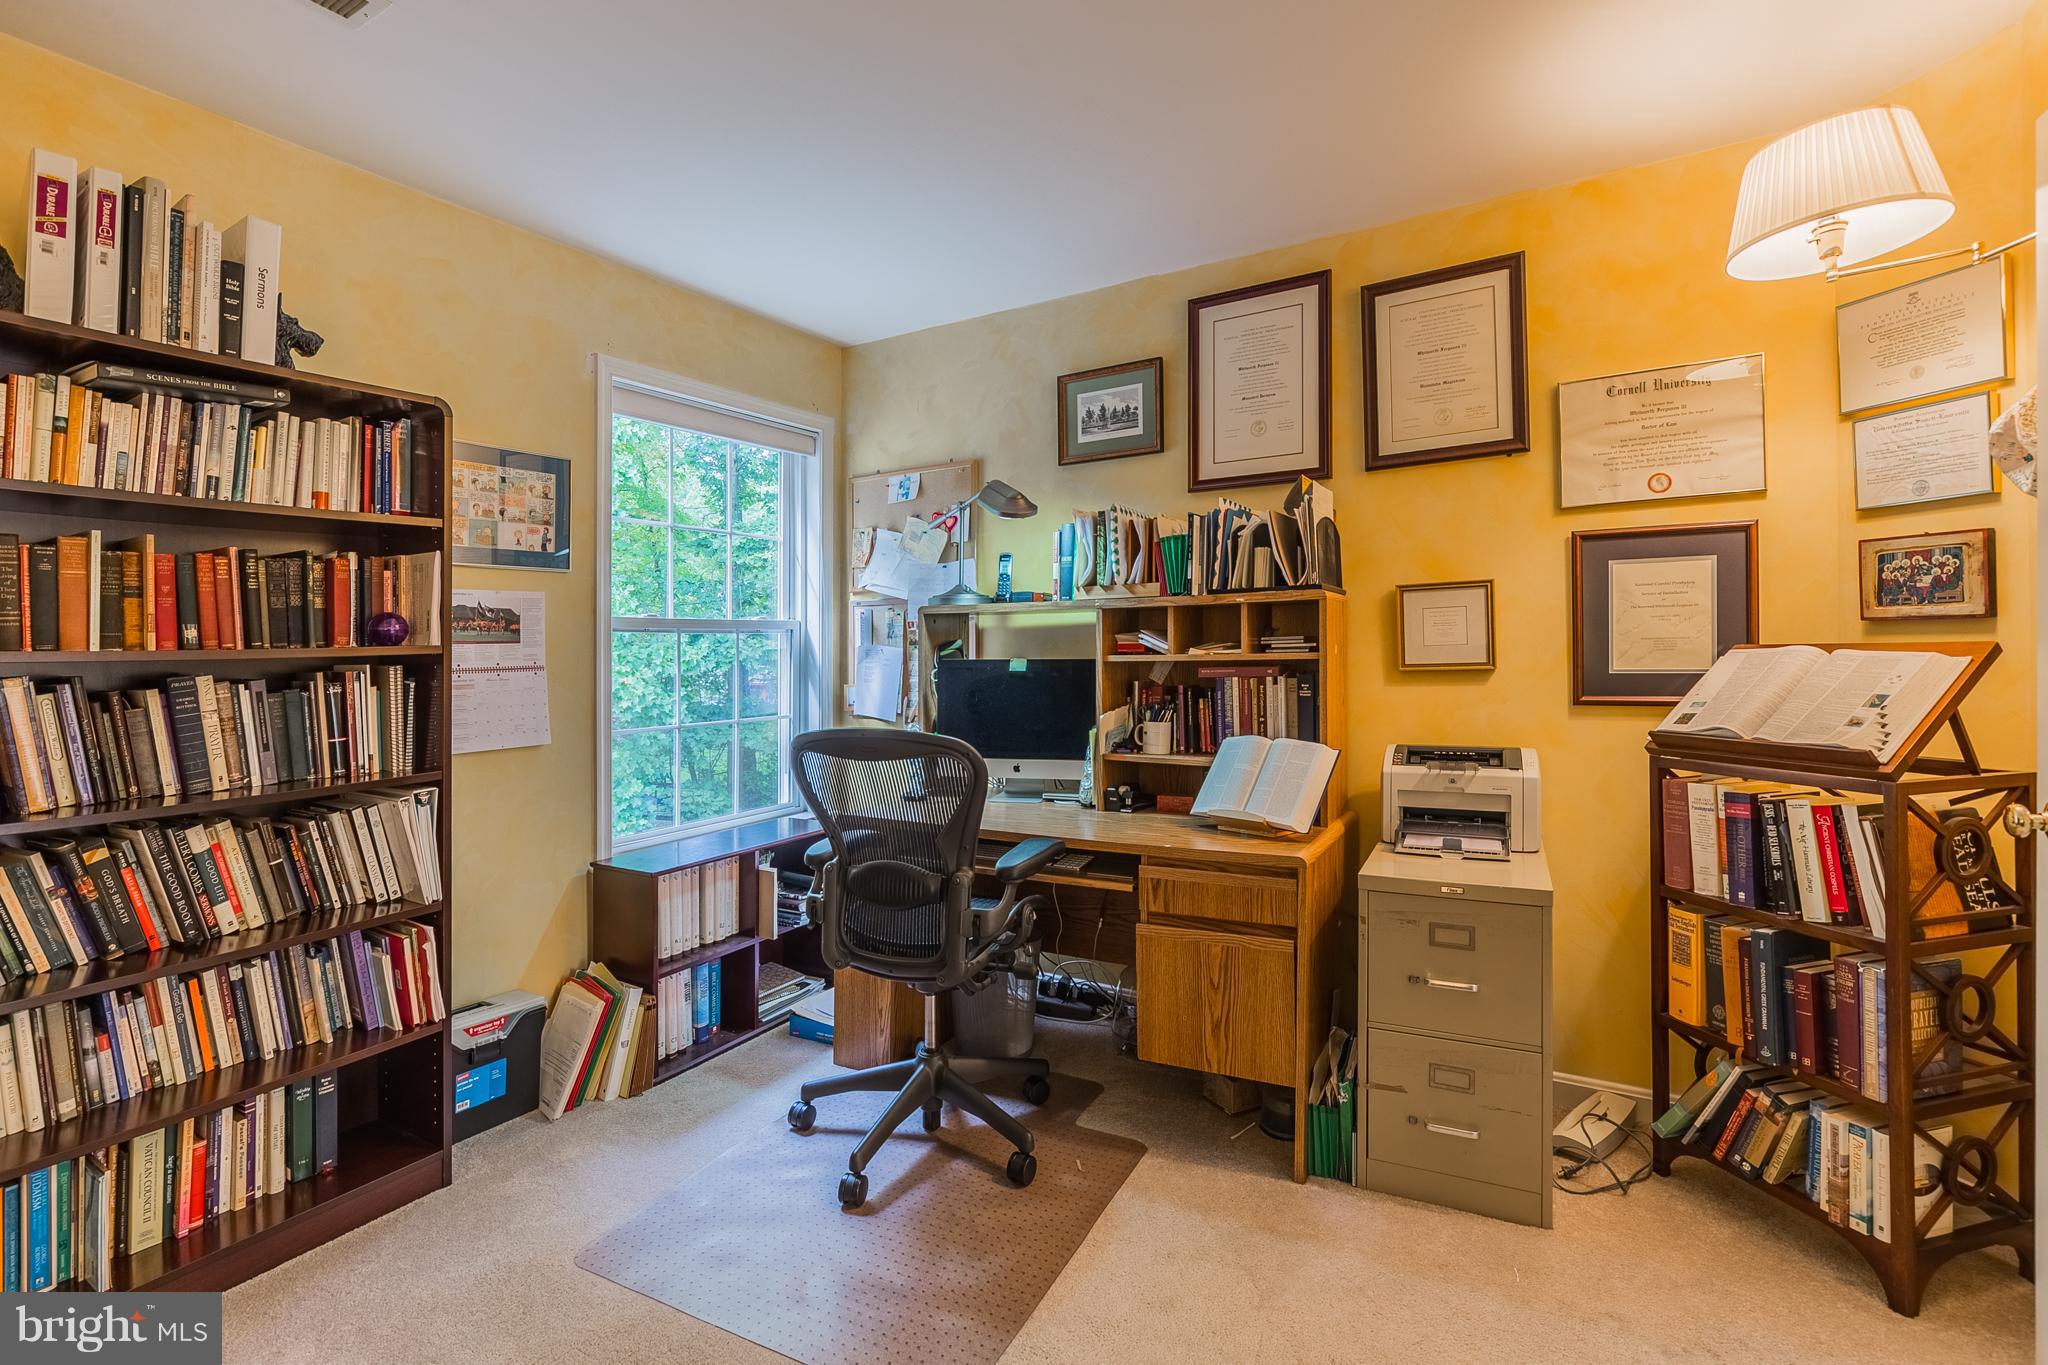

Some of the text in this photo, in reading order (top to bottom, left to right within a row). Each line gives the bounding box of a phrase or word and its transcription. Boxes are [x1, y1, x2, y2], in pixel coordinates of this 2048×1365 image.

[46, 187, 59, 216] DURABLE
[103, 202, 112, 228] DURABLE
[257, 267, 268, 309] Sermons
[146, 373, 180, 383] SCENES
[213, 383, 237, 391] BIBLE
[1606, 384, 1647, 398] Cornell
[383, 423, 391, 452] FARRER
[203, 678, 213, 707] YANCEY
[208, 724, 223, 761] PRAYER
[1762, 803, 1775, 818] JESUS
[1770, 846, 1782, 866] SCROLLS
[69, 853, 84, 877] EHRMAN
[1737, 835, 1745, 867] OTHER
[1816, 813, 1838, 895] ANCIENT CHRISTIAN GOSPELS
[1952, 836, 1969, 873] EAD
[174, 830, 191, 855] PETER
[187, 862, 204, 894] GOMES
[199, 895, 216, 926] SERMONS
[205, 860, 226, 902] GOOD LIFE
[367, 855, 382, 888] CLASSICS
[383, 856, 396, 888] CLASSICS
[1805, 872, 1815, 894] Library
[101, 869, 131, 925] GOD'S BREATH
[159, 853, 193, 927] THE GOOD BOOK
[97, 918, 112, 942] PROBLEM
[173, 990, 182, 1006] Good
[176, 1013, 184, 1024] Go
[1771, 1144, 1788, 1170] TEMPLE
[1852, 1137, 1864, 1173] PRAYER
[31, 1173, 42, 1211] JUDAISM
[143, 1142, 154, 1224] VATICAN COUNCIL II
